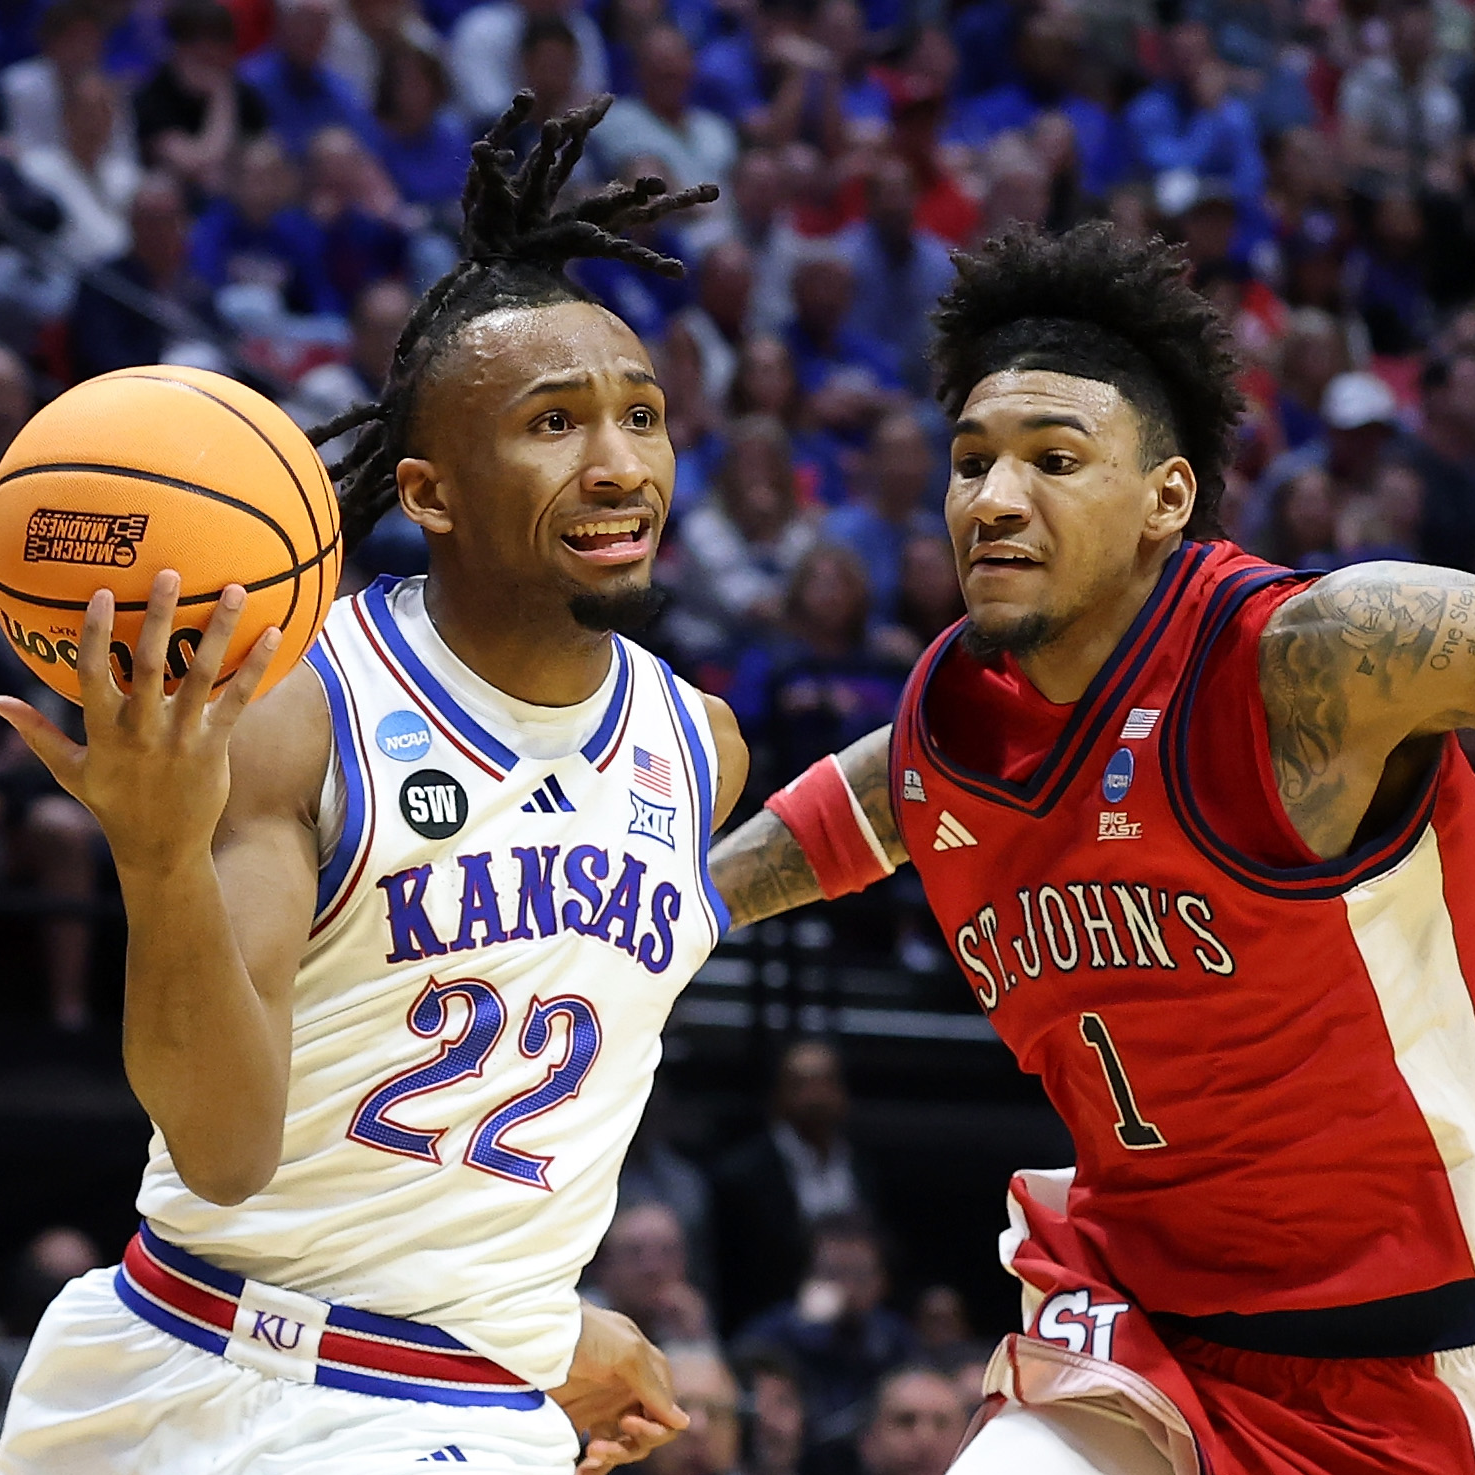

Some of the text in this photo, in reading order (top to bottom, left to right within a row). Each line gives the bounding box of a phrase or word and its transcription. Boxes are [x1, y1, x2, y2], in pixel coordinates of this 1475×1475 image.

[28, 515, 111, 541] MADNESS
[51, 538, 116, 564] MARCH
[1430, 627, 1463, 670] One
[385, 730, 430, 751] NCAA
[406, 785, 458, 824] SW
[1099, 811, 1128, 825] BIG
[1098, 822, 1141, 836] EAST
[376, 844, 682, 974] KANSAS
[956, 881, 1236, 1011] ST. JOHN'S
[346, 975, 603, 1192] 22
[1078, 1011, 1169, 1150] 1
[249, 1310, 306, 1351] KU
